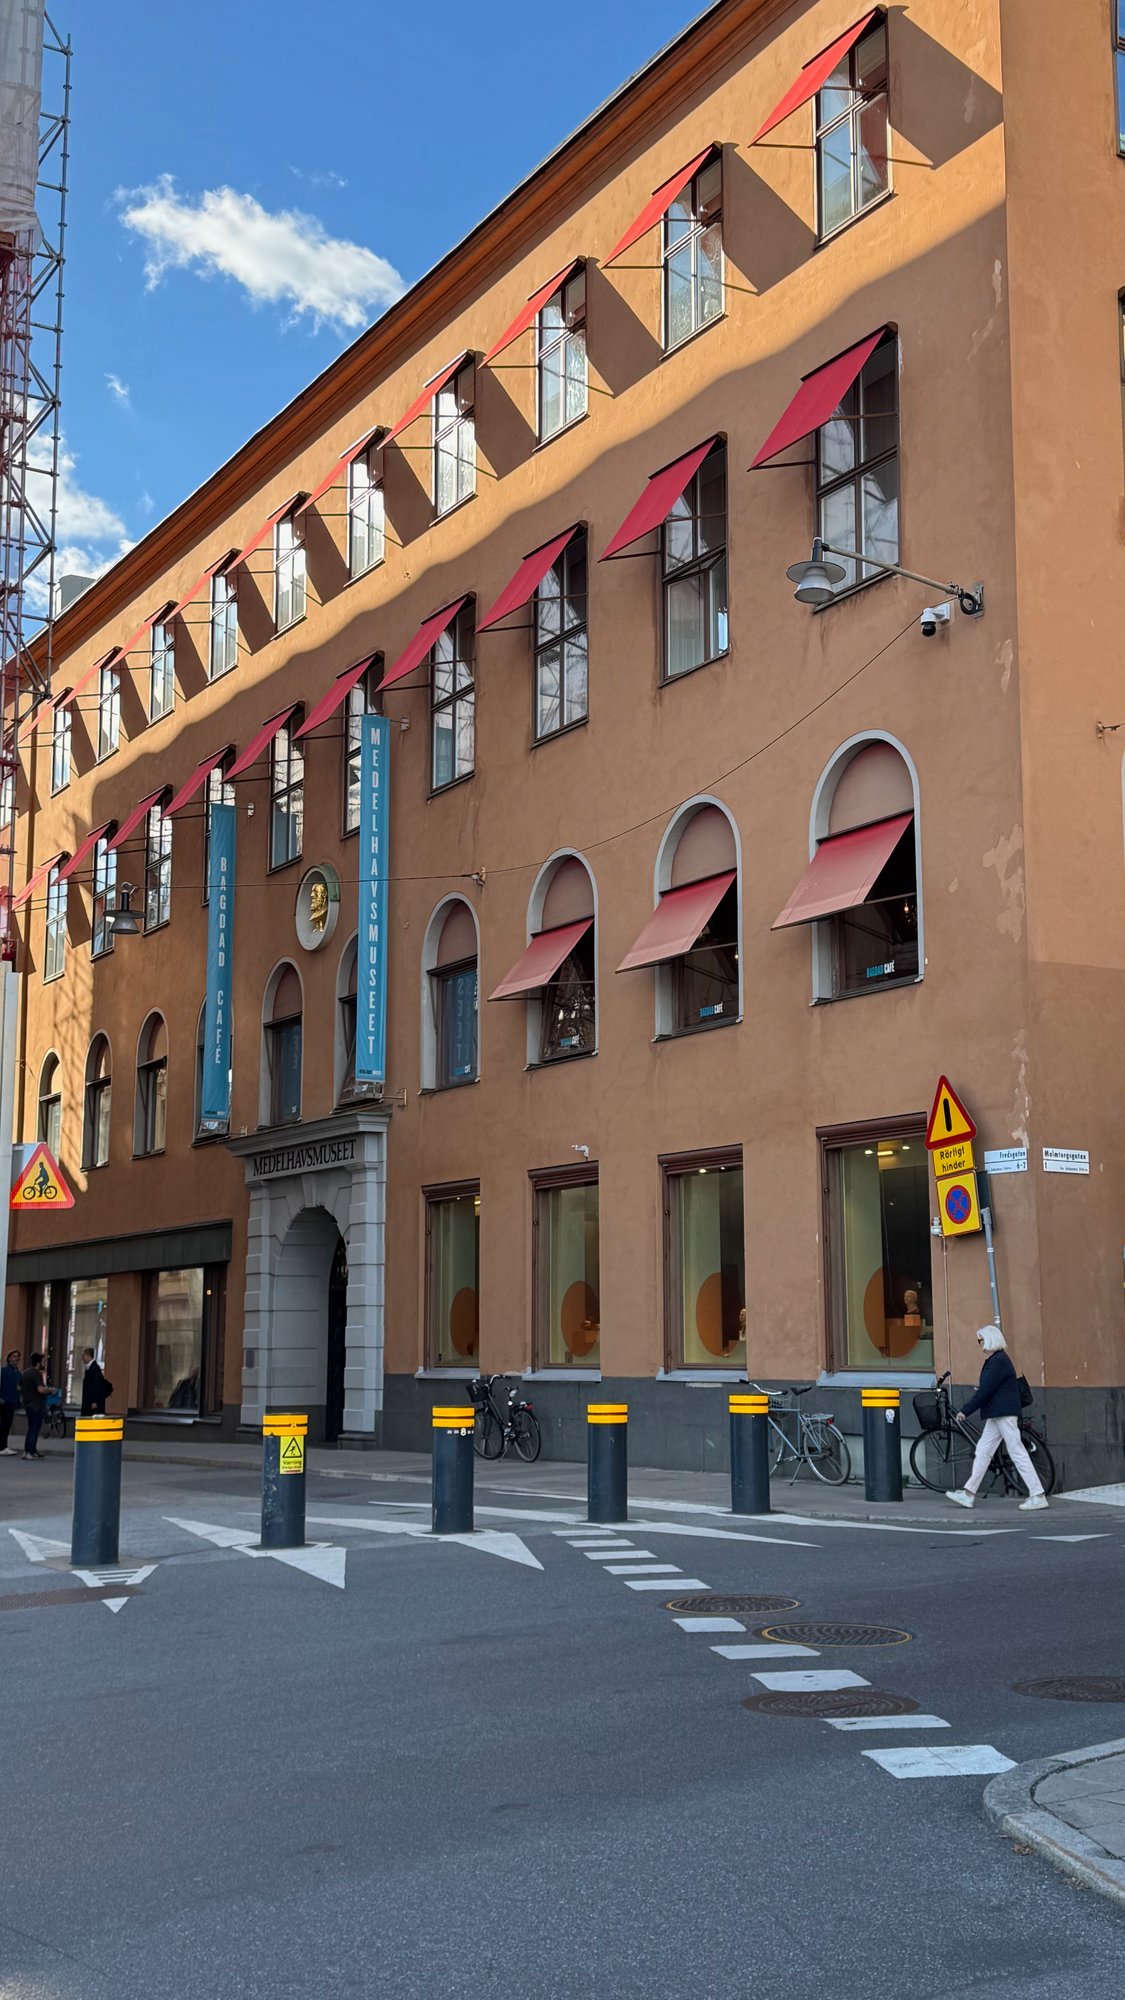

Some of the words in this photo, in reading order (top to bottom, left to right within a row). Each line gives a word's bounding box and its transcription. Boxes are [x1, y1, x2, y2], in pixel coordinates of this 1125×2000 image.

[368, 727, 381, 1054] MEDELHAVSMUSEET
[218, 856, 227, 967] BAGDAD
[215, 990, 224, 1064] CAFÉ
[253, 1139, 357, 1177] MEDELHAVSMUSEET
[940, 1146, 965, 1160] Rörligt
[942, 1160, 966, 1172] hinder
[999, 1151, 1026, 1160] Fredsgatan
[1045, 1150, 1087, 1160] Malmtorgsgatan
